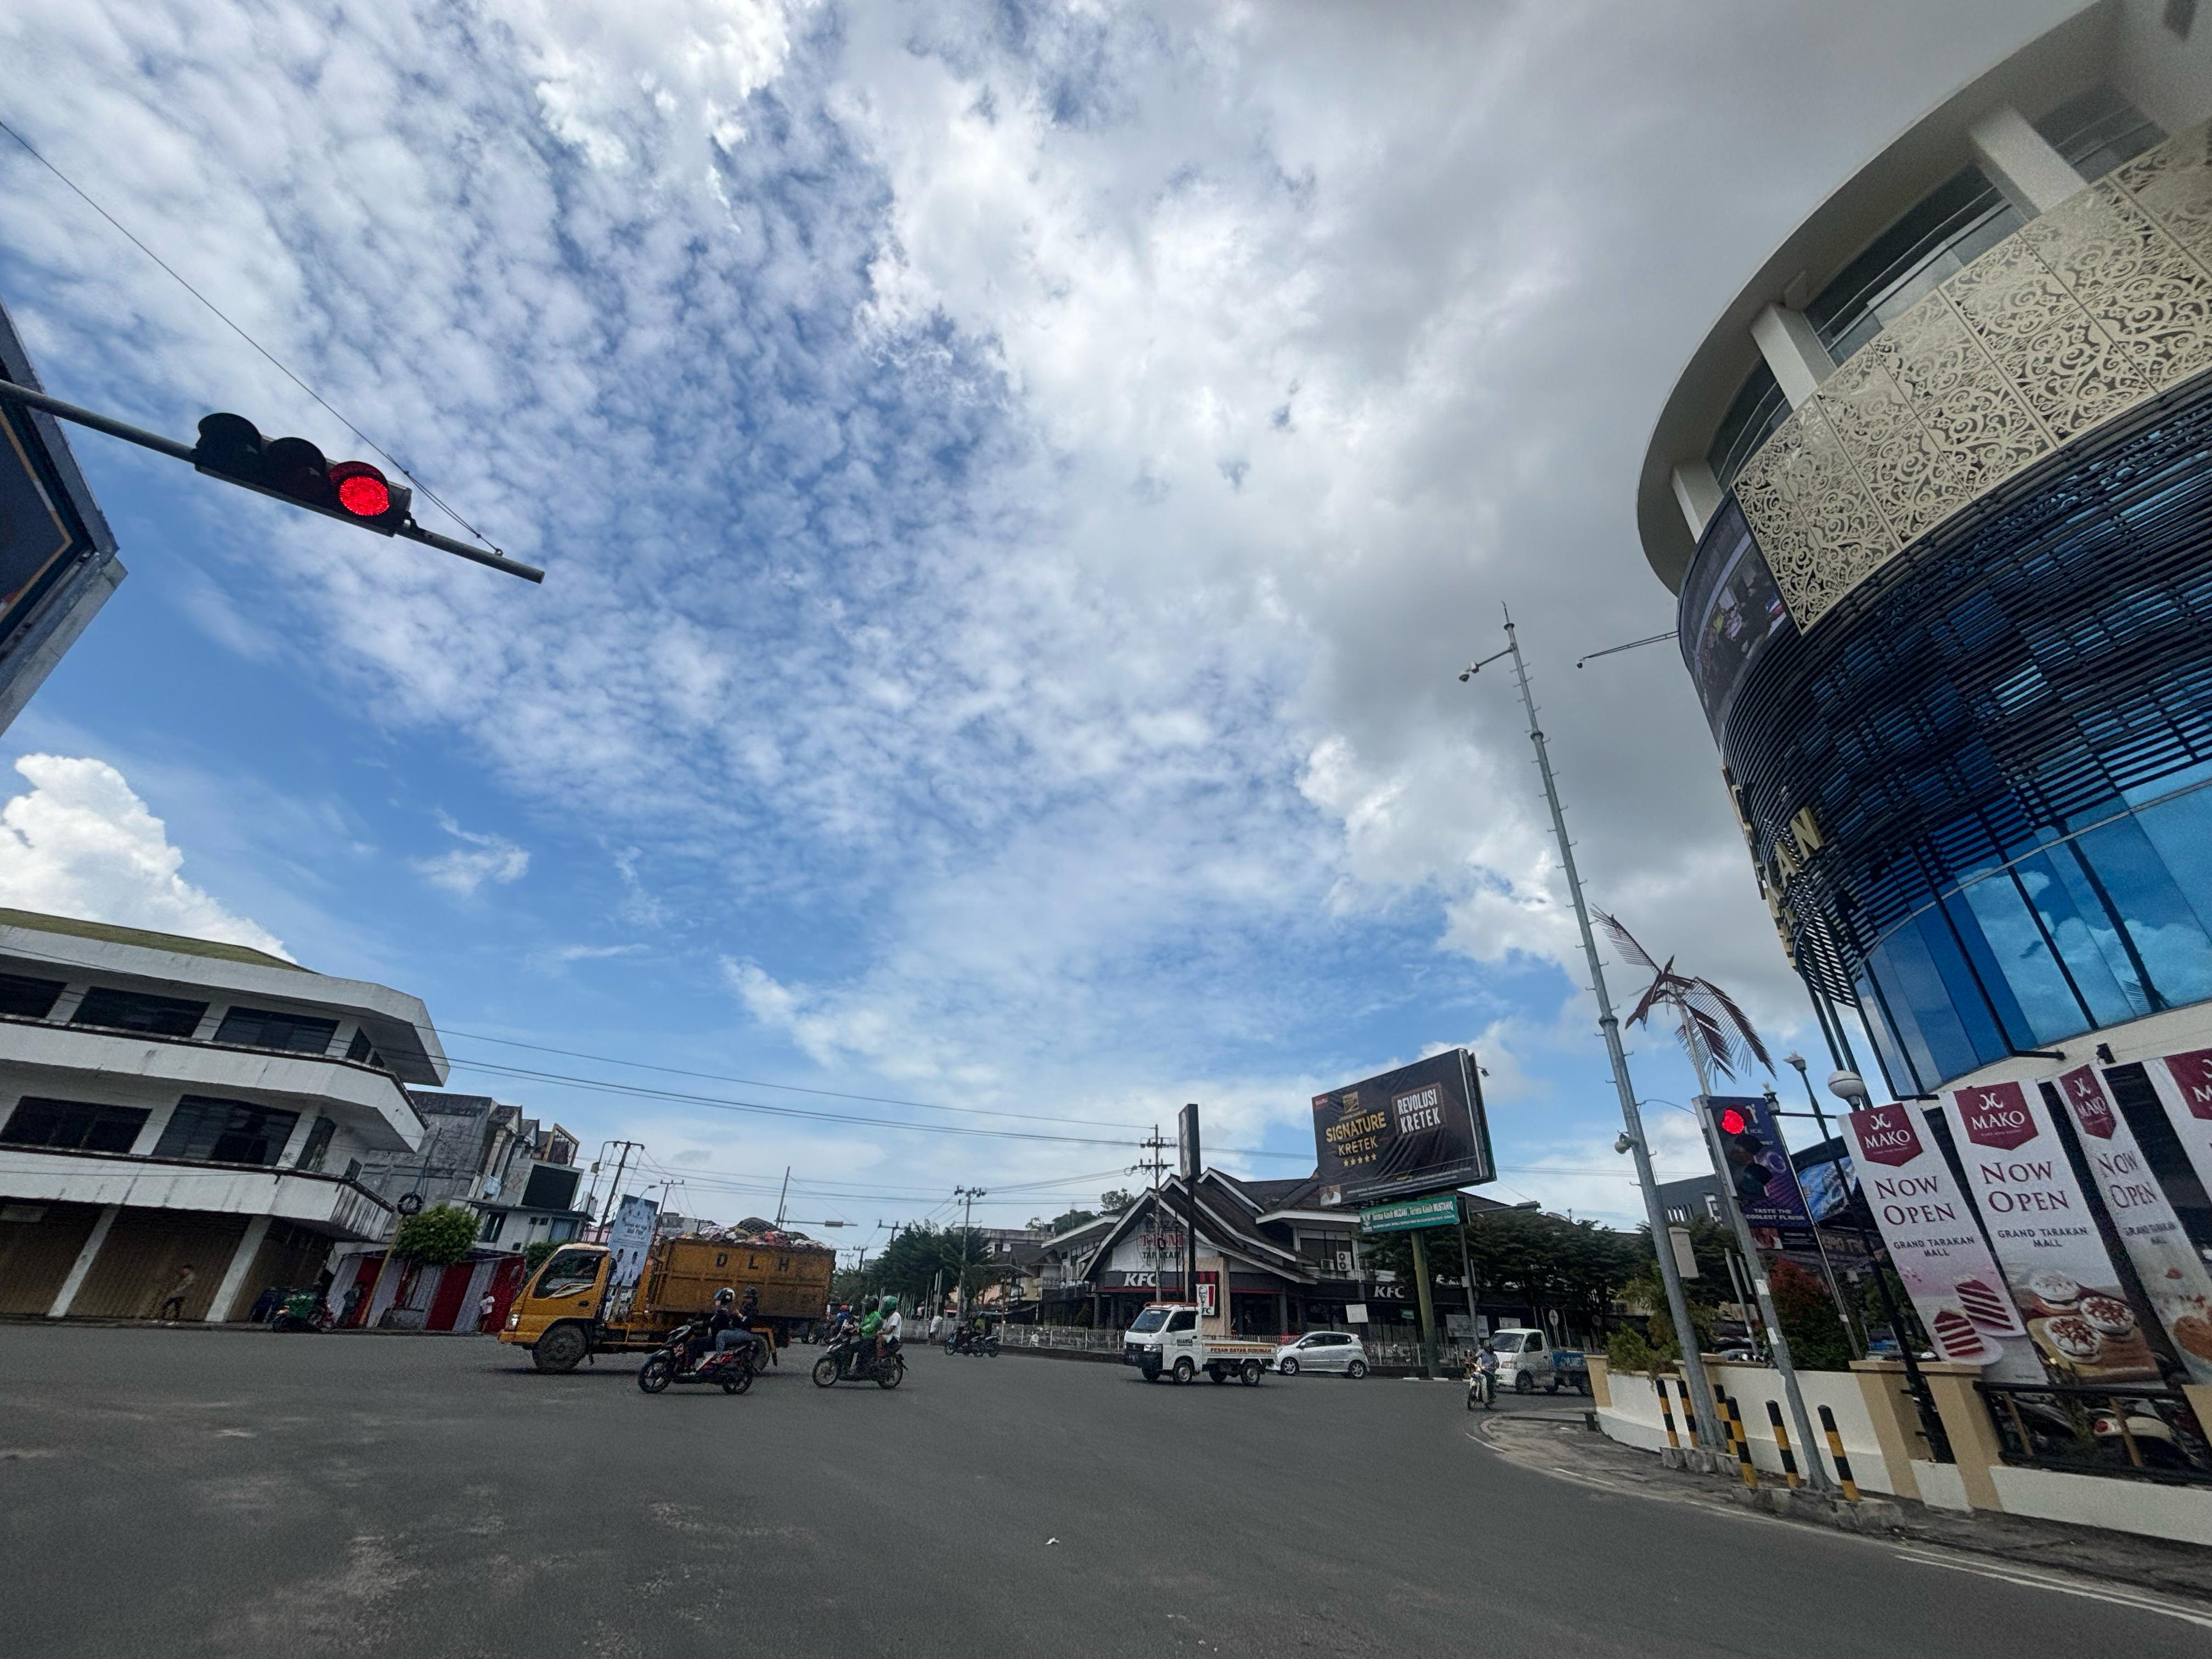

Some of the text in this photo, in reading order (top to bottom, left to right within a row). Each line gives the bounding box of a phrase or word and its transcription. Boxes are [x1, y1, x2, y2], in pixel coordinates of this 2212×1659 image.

[1397, 1088, 1437, 1115] REVOLUSI
[2077, 1096, 2107, 1118] MAKO
[1325, 1111, 1387, 1143] SIGNATURE
[1400, 1107, 1441, 1134] KRETEK
[1971, 1110, 2025, 1130] MAKO
[1338, 1135, 1378, 1156] KRETEK
[1865, 1130, 1910, 1148] MAKO
[1997, 1227, 2088, 1238] GRAND TARAKAN
[1893, 1236, 1975, 1249] GRAND TARAKAN
[2033, 1239, 2063, 1248] MALL
[1923, 1248, 1950, 1257] MALL
[1124, 1273, 1156, 1287] KFC
[1374, 1286, 1404, 1299] KFC
